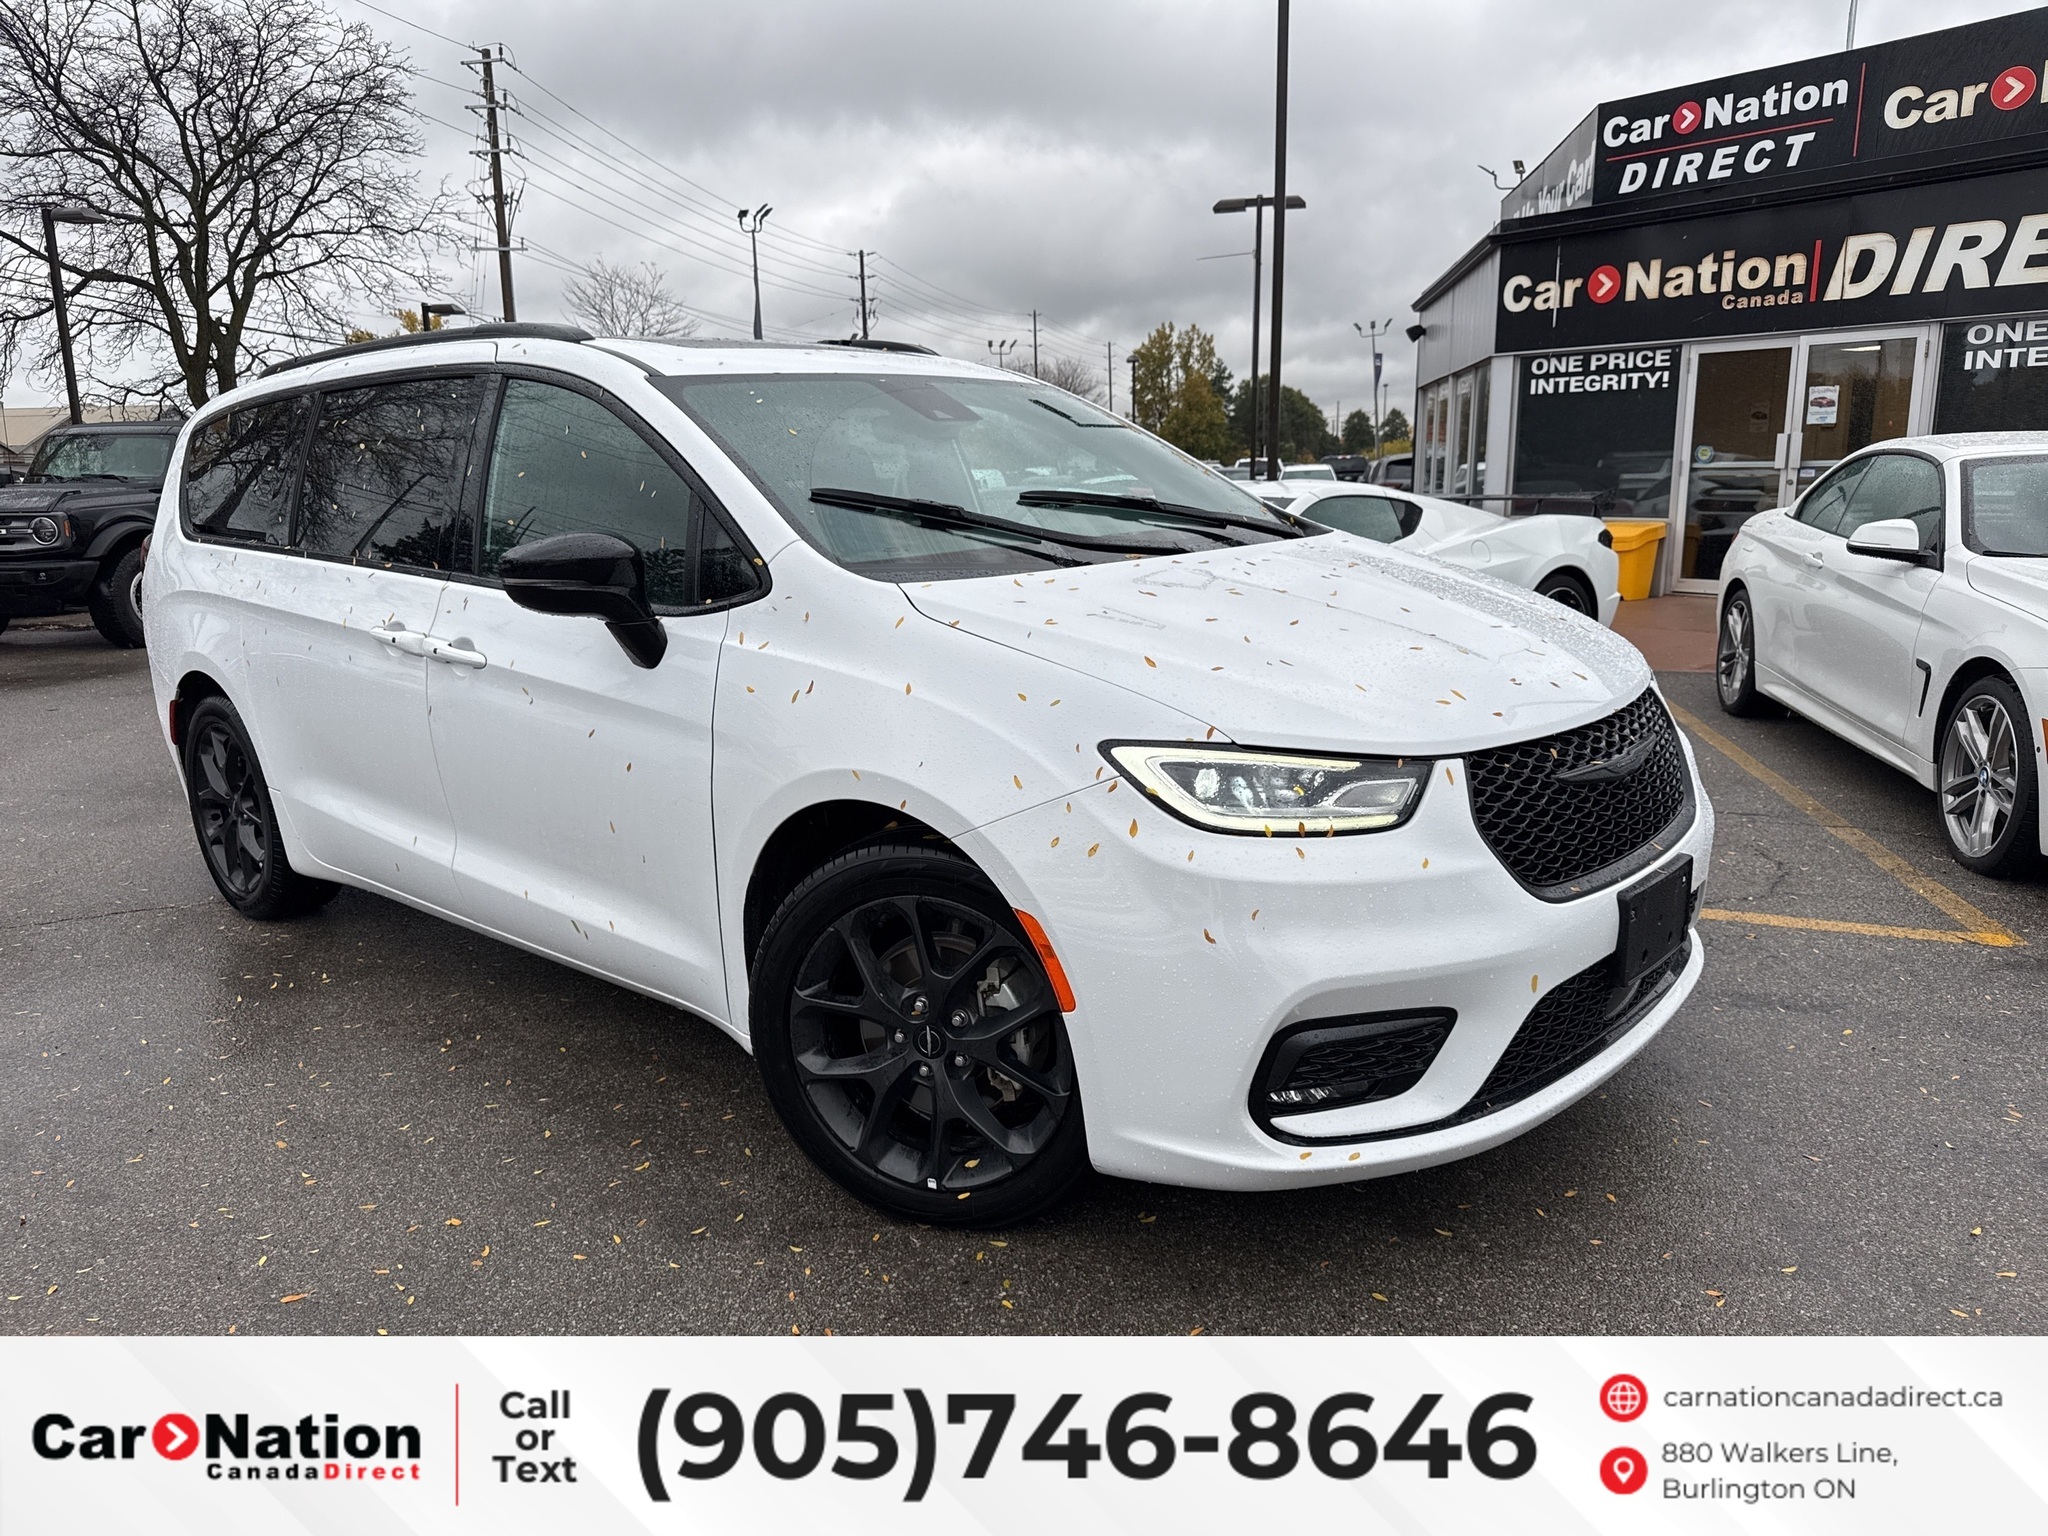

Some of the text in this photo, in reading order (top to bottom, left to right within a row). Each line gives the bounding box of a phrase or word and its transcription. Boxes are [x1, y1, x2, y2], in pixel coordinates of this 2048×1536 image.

[1603, 79, 1849, 148] Car Nation
[1884, 85, 1989, 130] Car
[1618, 131, 1817, 195] DIRECT
[1822, 213, 2048, 302] DIRE
[1503, 249, 1809, 313] Car Nation
[1721, 289, 1804, 311] Canada
[1967, 319, 2048, 345] ONE
[1530, 349, 1672, 375] ONE PRICE
[1963, 346, 2048, 371] INTE
[1529, 371, 1670, 396] INTEGRITY!
